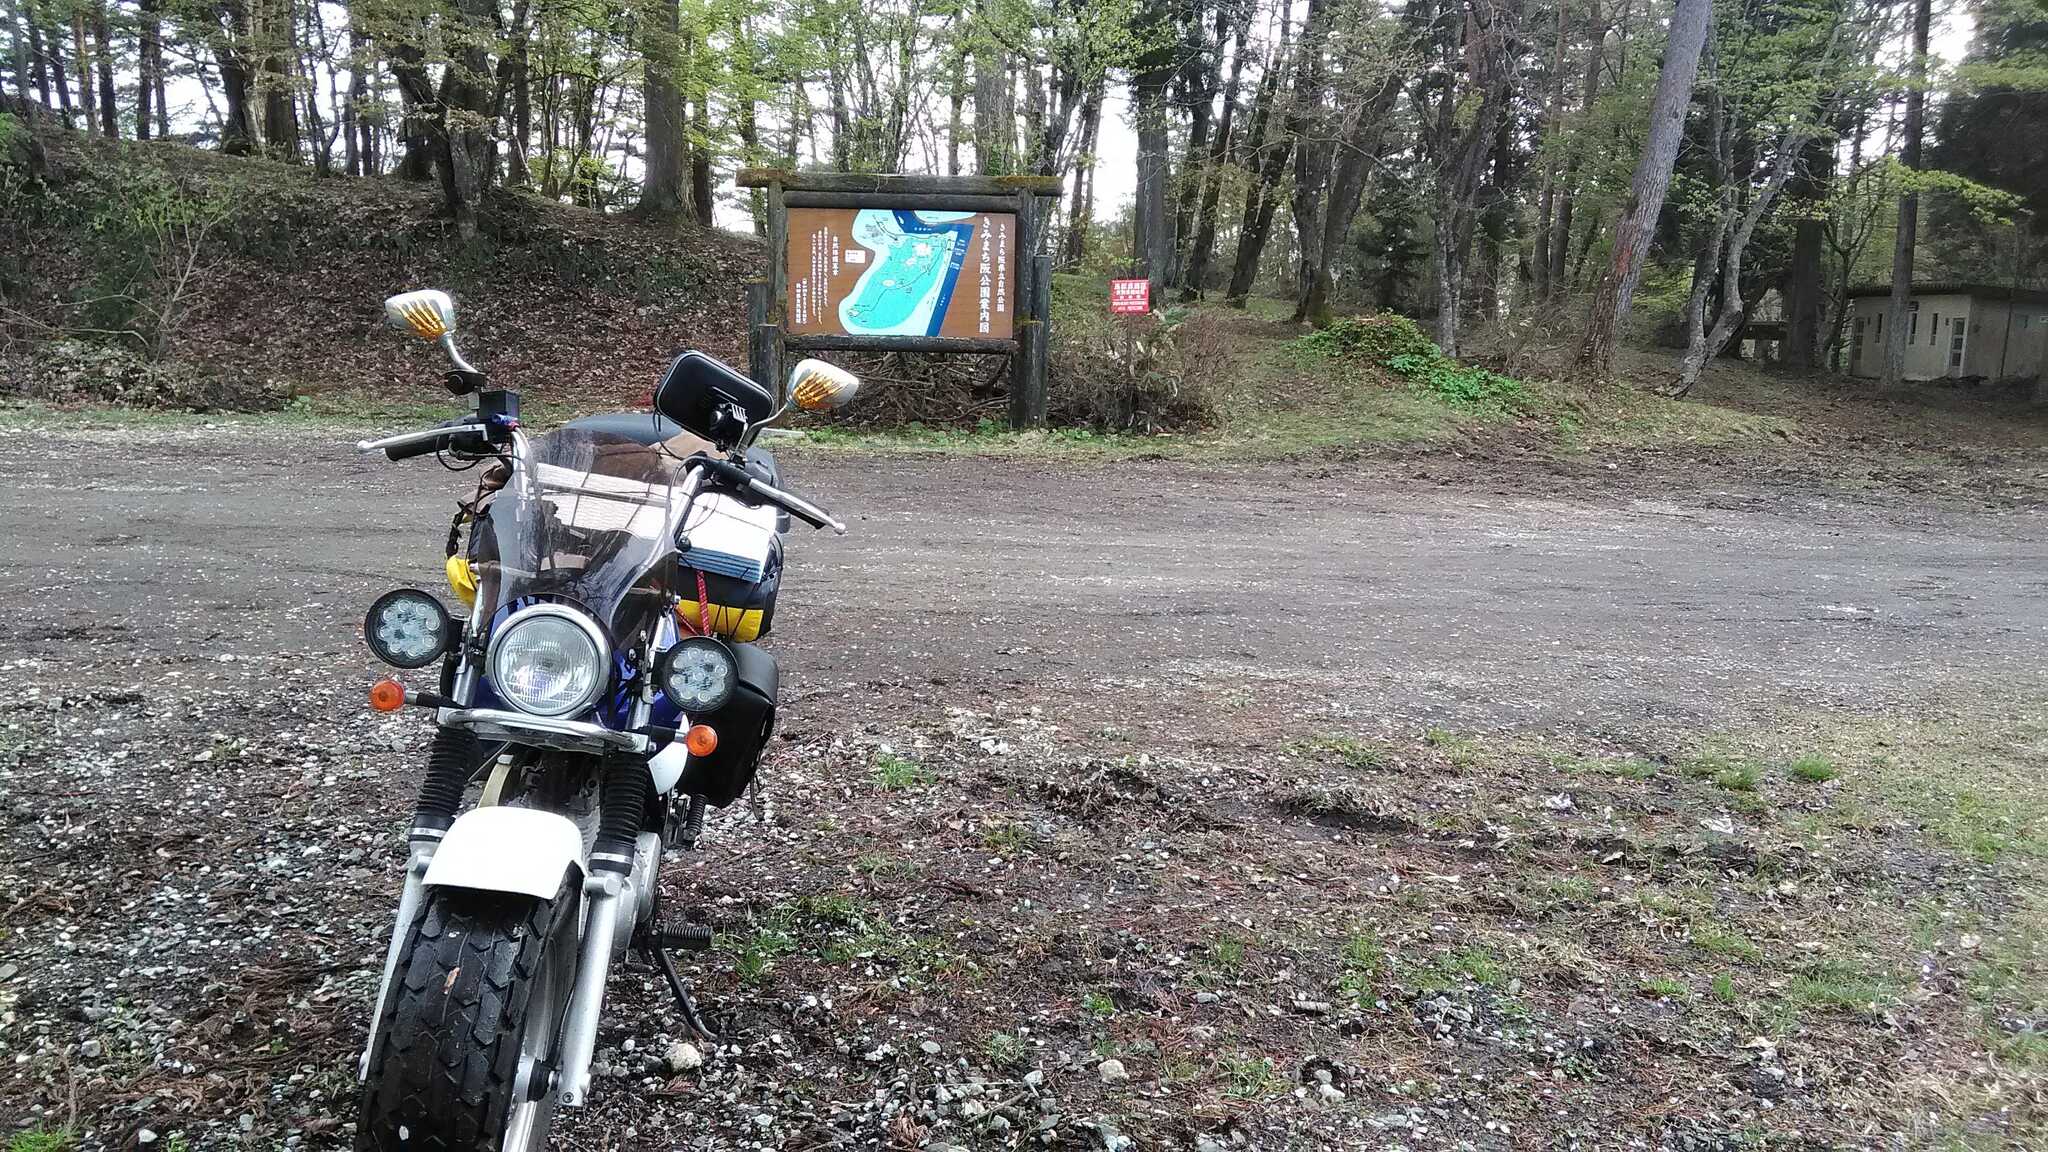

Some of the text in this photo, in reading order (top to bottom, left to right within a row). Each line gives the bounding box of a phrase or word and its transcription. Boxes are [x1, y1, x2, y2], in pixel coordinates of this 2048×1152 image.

[979, 216, 992, 334] きみまち阪公園案内図
